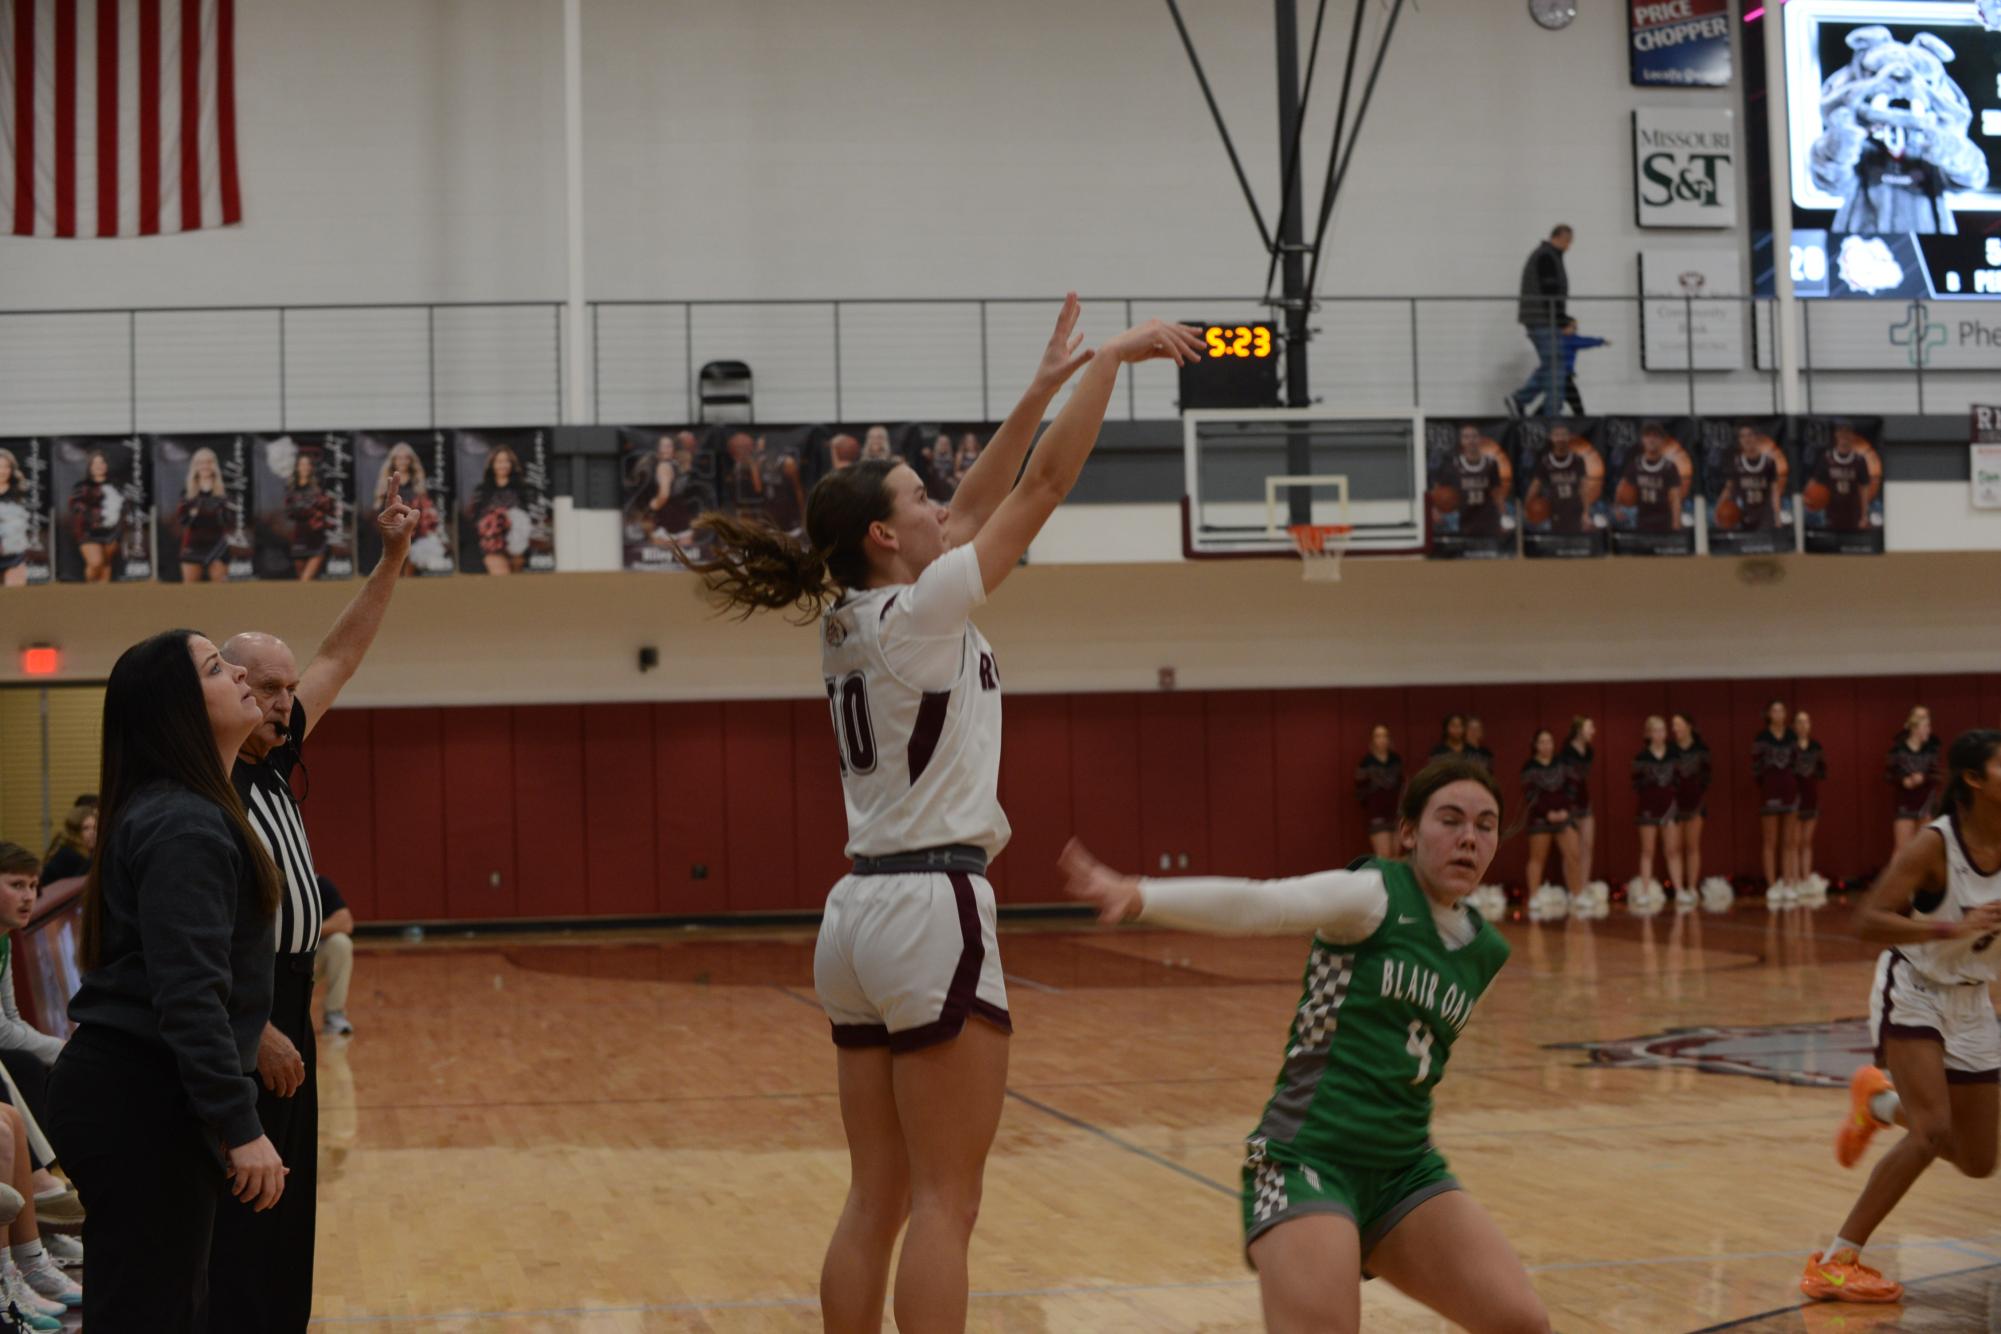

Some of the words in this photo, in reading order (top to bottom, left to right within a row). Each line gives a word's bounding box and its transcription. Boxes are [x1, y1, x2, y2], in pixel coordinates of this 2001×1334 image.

[1634, 1, 1692, 26] PRICE
[1633, 17, 1728, 51] CHOPPER
[1641, 128, 1730, 149] MISSOURI
[1643, 152, 1731, 207] S&T
[1205, 326, 1271, 358] 5:23
[979, 652, 1000, 690] R
[1380, 958, 1440, 1010] BLAIR
